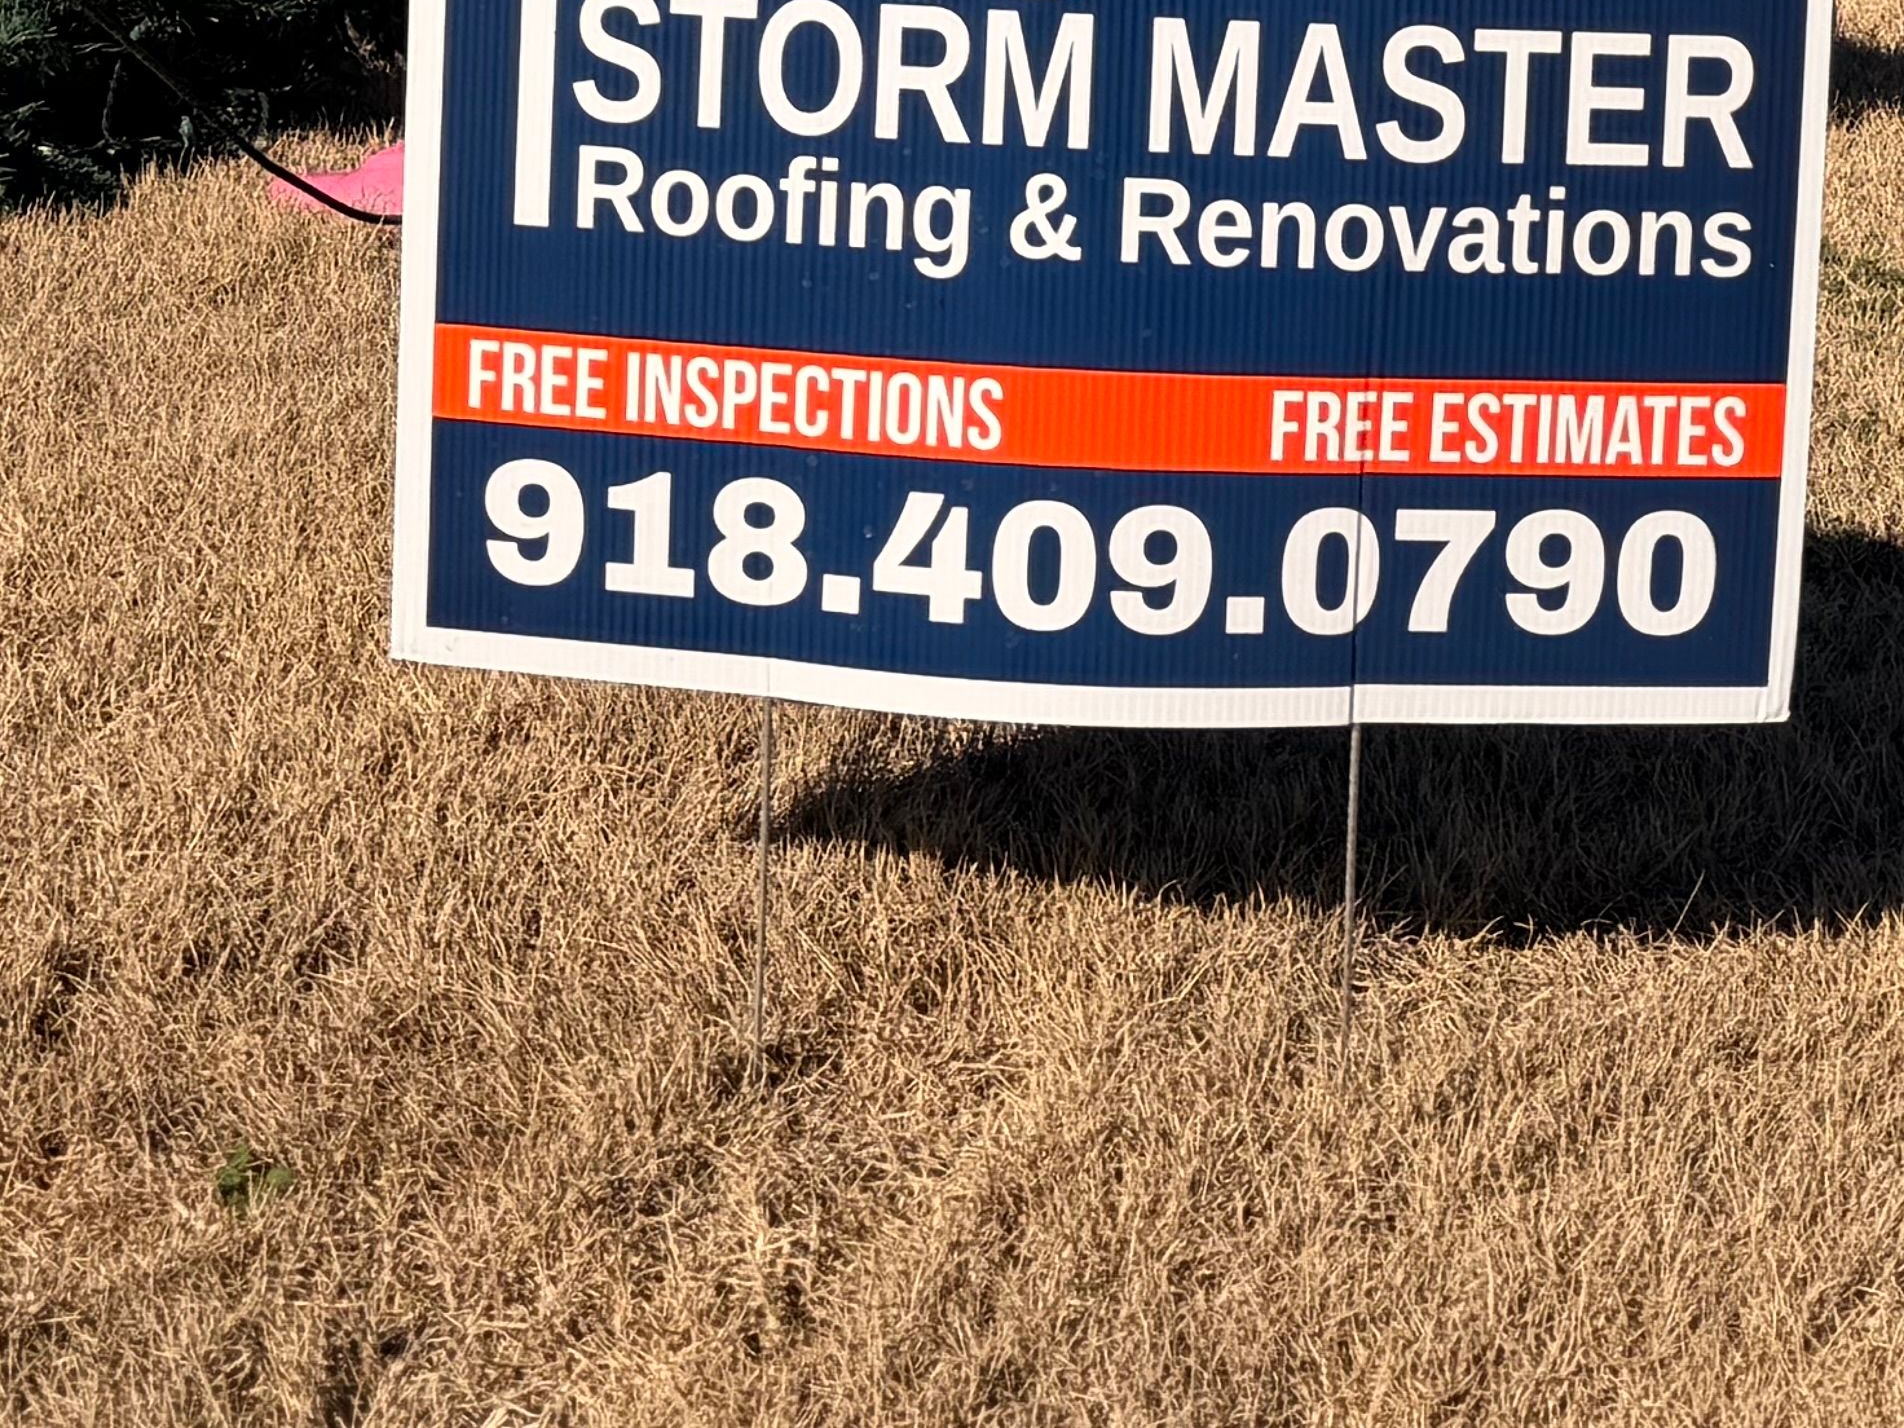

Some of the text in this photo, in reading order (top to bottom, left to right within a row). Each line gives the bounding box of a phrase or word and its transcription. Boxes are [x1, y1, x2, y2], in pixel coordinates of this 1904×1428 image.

[1148, 16, 1754, 169] MASTER
[577, 144, 1752, 279] Roofing & Renovations
[468, 339, 1003, 451] FREE INSPECTIONS
[1270, 390, 1746, 467] FREE ESTIMATES
[484, 457, 1717, 636] 918.409.0790
